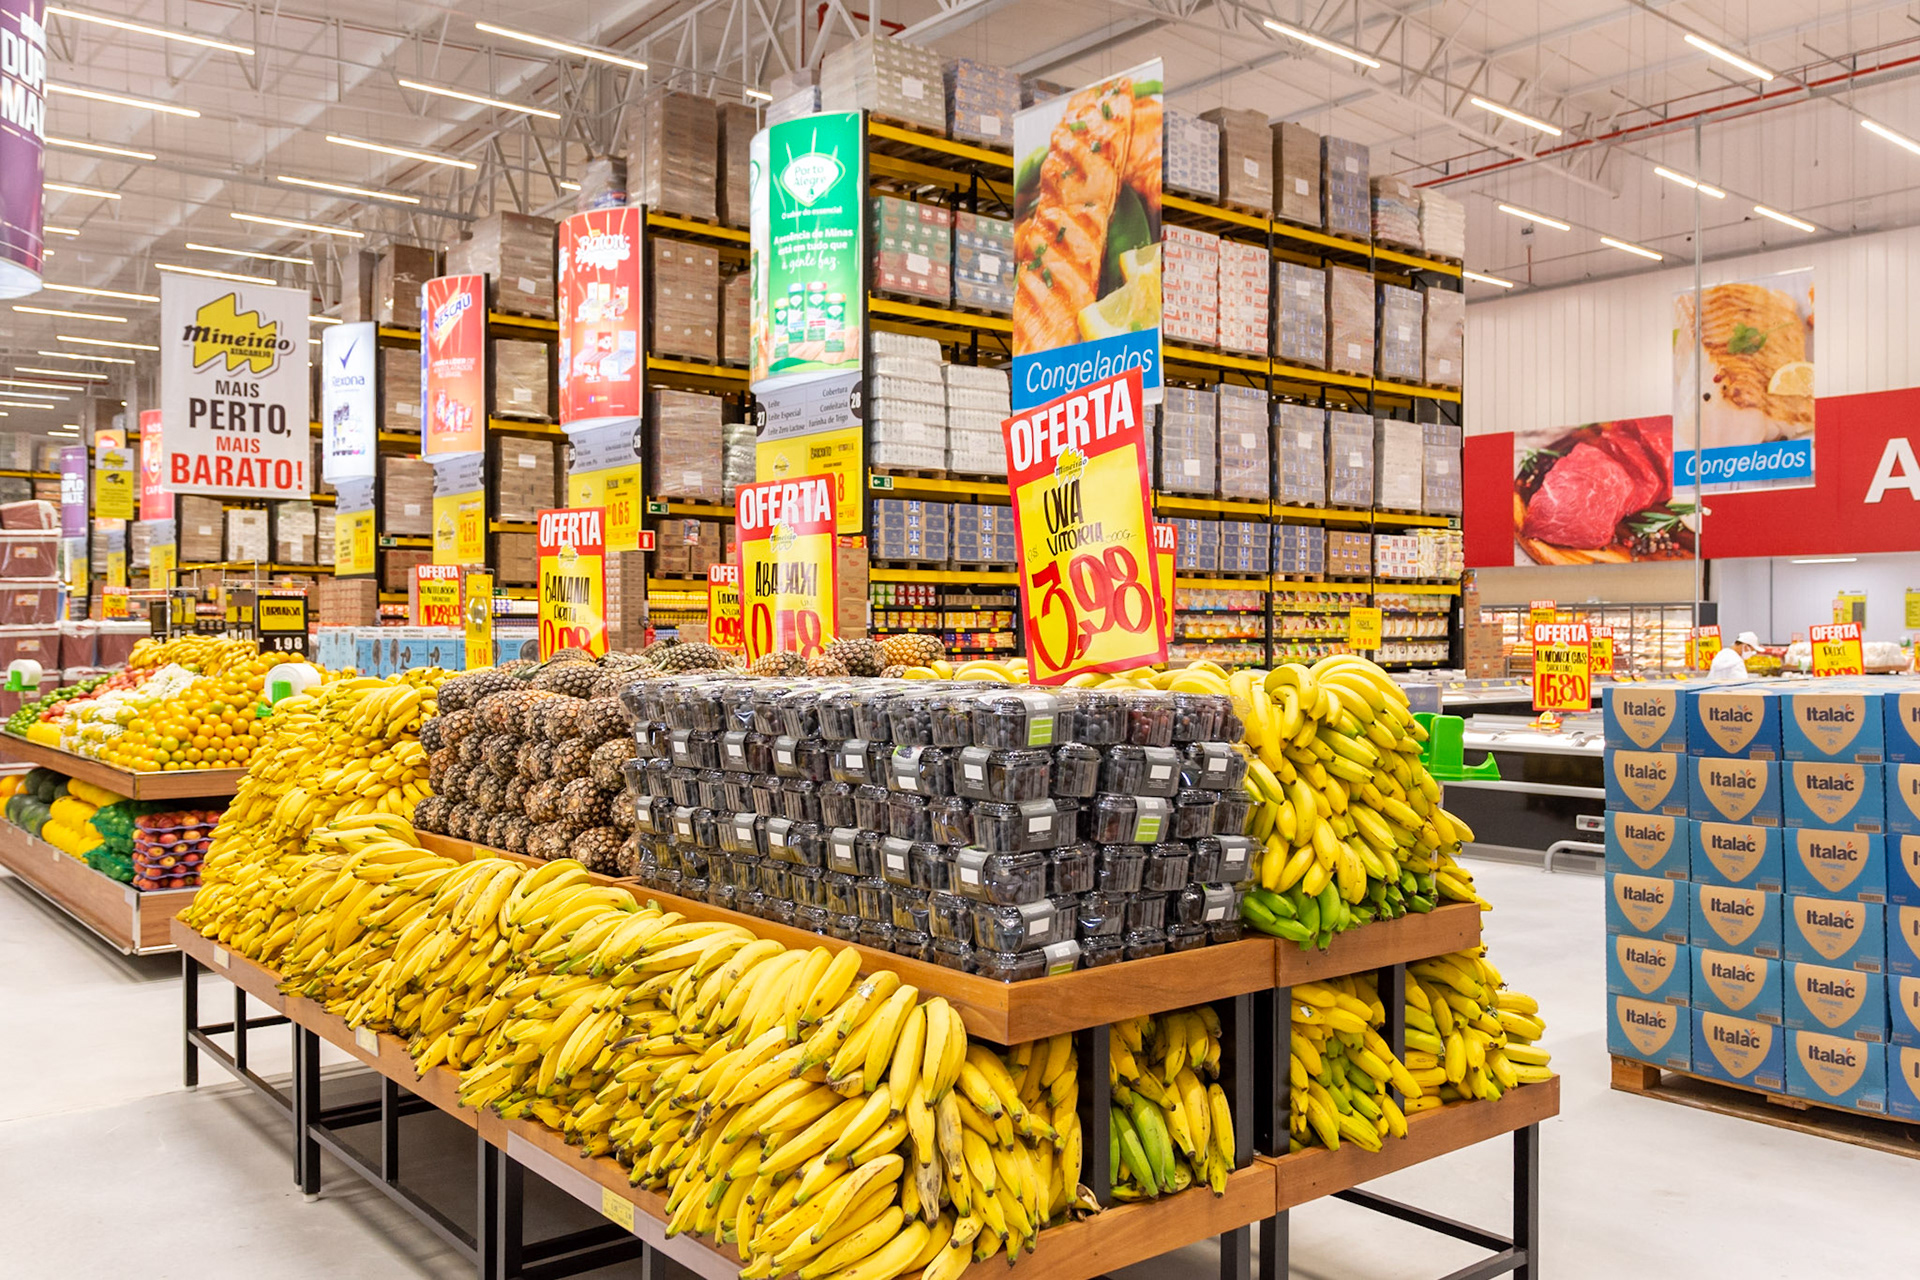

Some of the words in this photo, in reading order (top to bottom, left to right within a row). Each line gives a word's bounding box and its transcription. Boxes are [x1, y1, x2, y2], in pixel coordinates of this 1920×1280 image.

[795, 165, 824, 175] Porto
[795, 176, 826, 187] Alegre
[812, 228, 823, 238] de
[824, 227, 854, 238] Minas
[793, 244, 806, 253] em
[807, 240, 829, 251] tudo
[830, 241, 848, 251] que
[789, 252, 817, 274] gente
[433, 293, 472, 331] NESCAU
[182, 324, 290, 351] Mineirão
[1026, 345, 1153, 394] Congelados
[215, 380, 260, 398] MAIS
[332, 374, 365, 387] Rexona
[822, 386, 848, 397] Cobertura
[768, 400, 780, 409] Leite
[820, 401, 848, 413] Confeitaria
[189, 398, 291, 438] PERTO,
[768, 412, 780, 421] Leite
[780, 408, 801, 419] Especial
[809, 418, 828, 428] Farinha
[828, 416, 834, 424] de
[835, 414, 848, 424] Trigo
[1010, 377, 1135, 472] OFERTA
[216, 436, 260, 454] MAIS
[171, 452, 303, 490] BARATO!
[1056, 458, 1088, 476] Mineirão
[1685, 449, 1806, 478] Congelados
[739, 479, 832, 530] OFERTA
[1043, 479, 1085, 535] UVA
[540, 511, 602, 547] OFERTA
[418, 566, 459, 578] OFERTA
[755, 560, 818, 597] ABACAXI
[545, 572, 590, 605] BANANA
[554, 604, 577, 623] PRATA
[1029, 545, 1153, 671] 3,98
[1531, 601, 1555, 609] OFERTA
[1534, 624, 1589, 642] OFERTA
[1812, 623, 1859, 641] OFERTA
[274, 637, 303, 651] 1,98
[1538, 673, 1586, 706] 15,80
[1623, 701, 1666, 717] Italac
[1709, 707, 1753, 723] Italac
[1806, 706, 1855, 723] Italac
[1624, 763, 1667, 781] Italac
[1710, 771, 1757, 790] Italac
[1806, 774, 1855, 792] Italac
[1625, 824, 1666, 842] Italac
[1711, 834, 1756, 853] Italac
[1809, 843, 1858, 862] Italac
[1623, 886, 1664, 905] Italac
[1710, 897, 1755, 917] Italac
[1806, 909, 1855, 930] Italac
[1626, 947, 1667, 968] Italac
[1711, 962, 1755, 983] Italac
[1807, 977, 1855, 999] Italac
[1626, 1008, 1667, 1029] Italac
[1713, 1025, 1760, 1049] Italac
[1808, 1044, 1856, 1068] Italac
